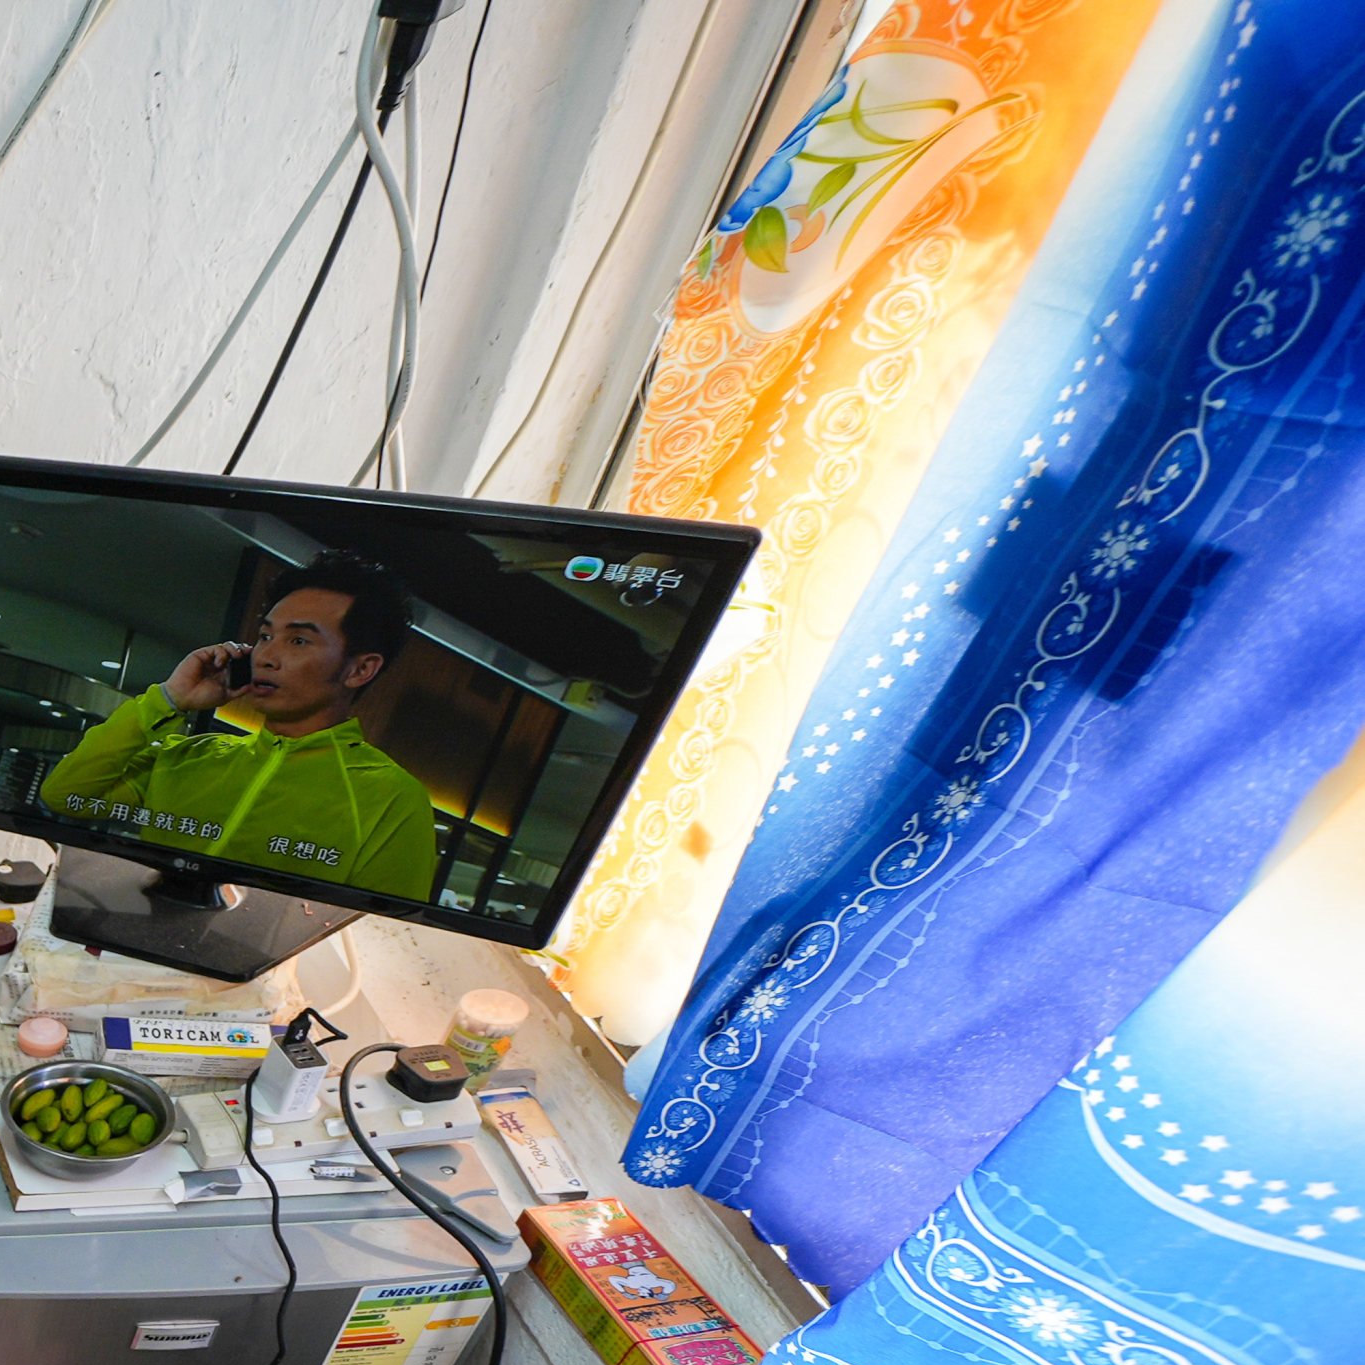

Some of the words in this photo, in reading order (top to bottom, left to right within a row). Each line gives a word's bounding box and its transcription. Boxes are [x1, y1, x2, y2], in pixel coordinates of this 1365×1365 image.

[602, 563, 684, 589] 翡翠台
[66, 794, 224, 841] 你不用遷就我的
[268, 835, 342, 867] 很想吃
[186, 862, 200, 872] LG
[139, 1027, 222, 1042] TORICAM
[227, 1033, 260, 1044] GEL
[378, 1284, 436, 1298] ENERGY
[439, 1280, 484, 1293] LABEL
